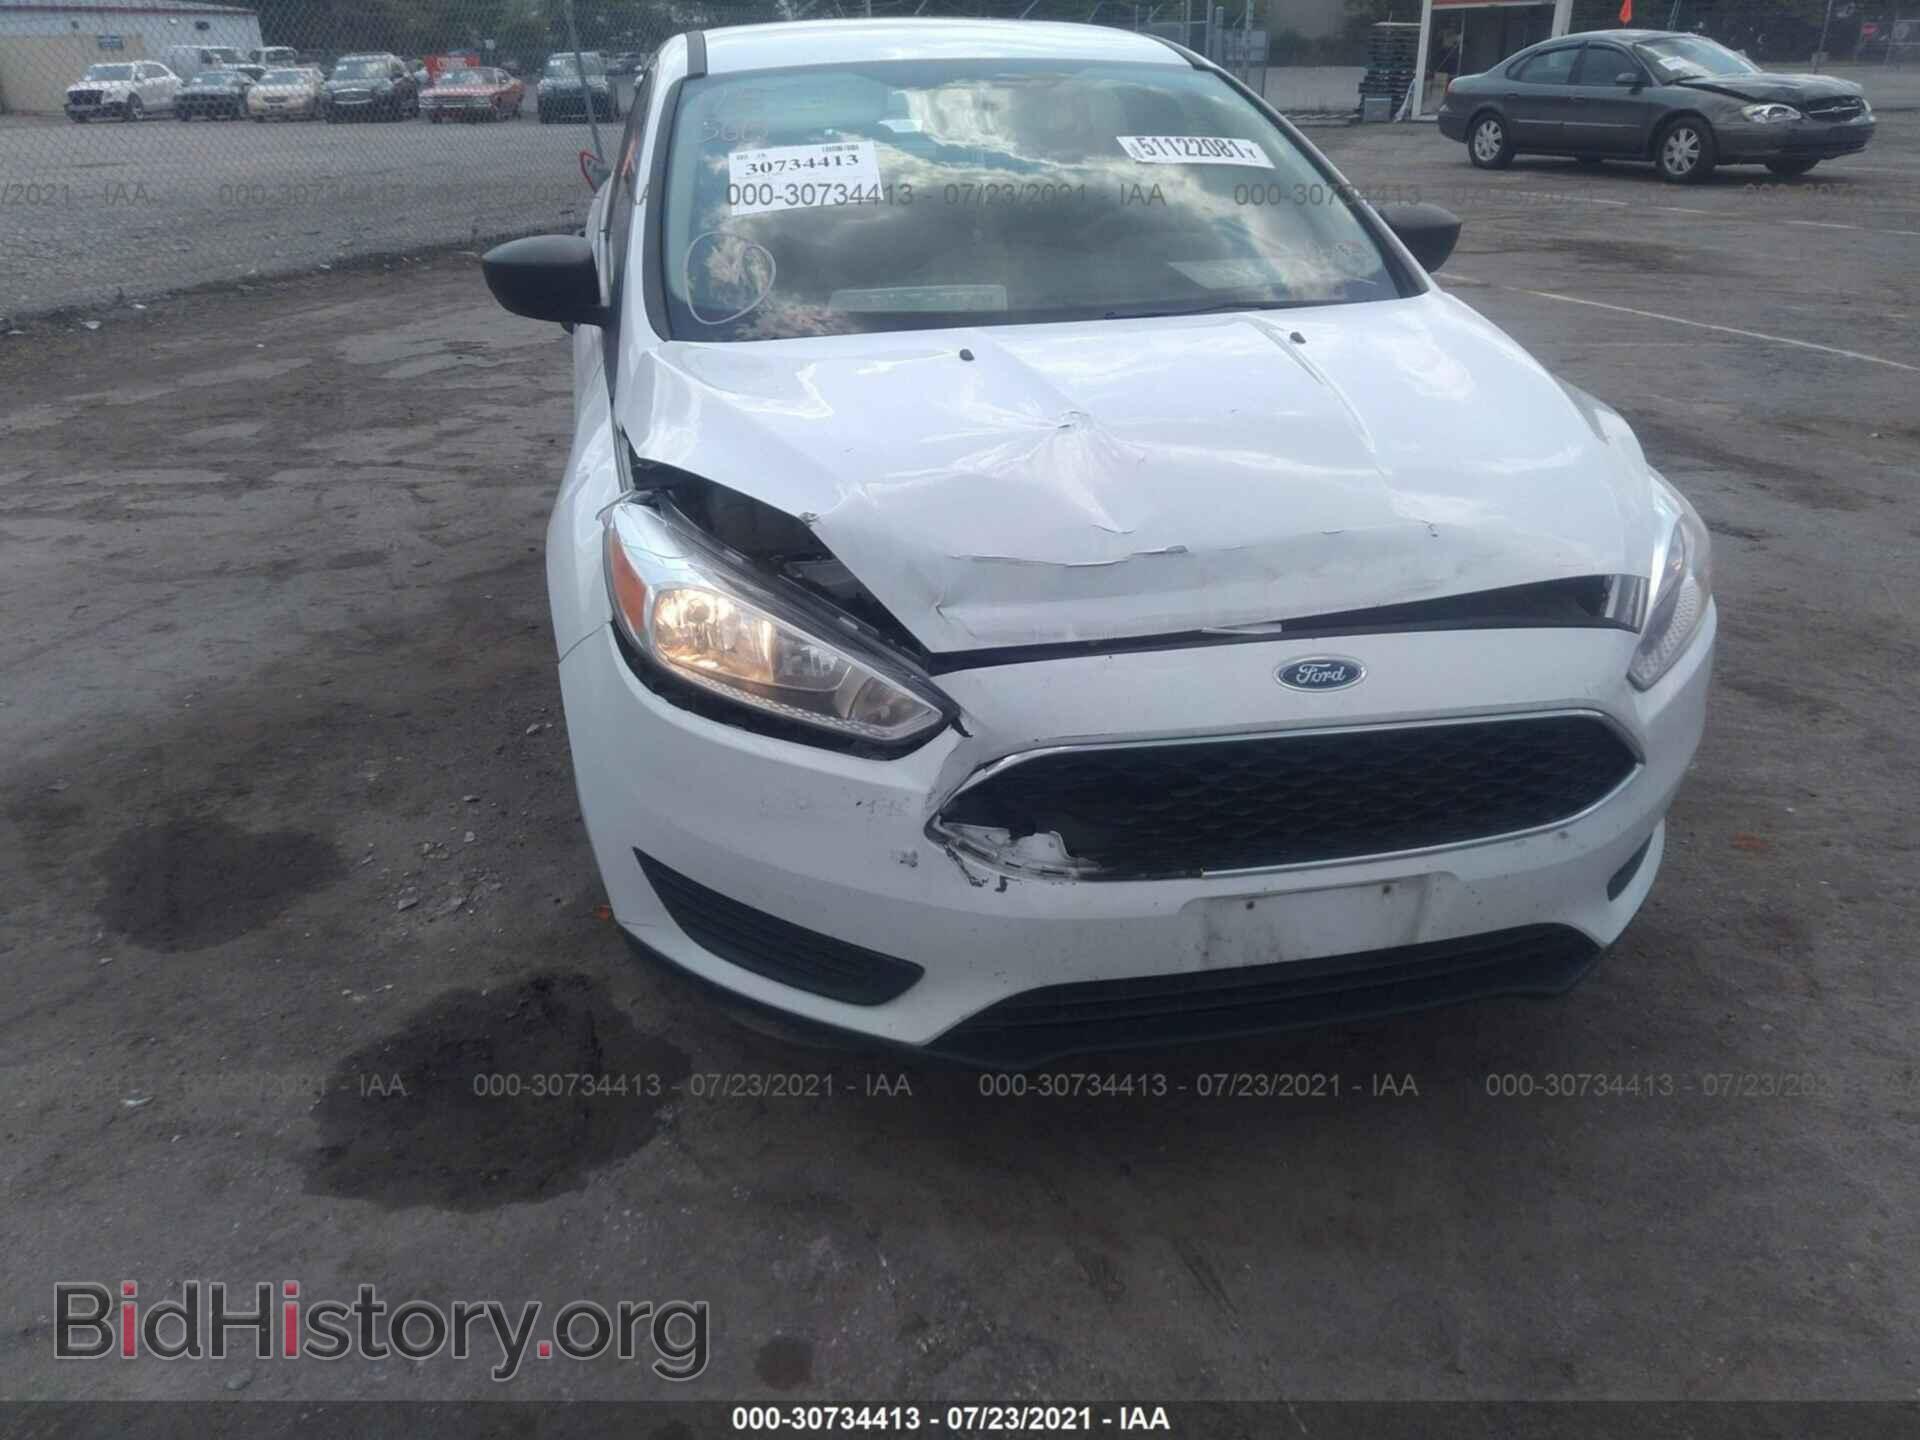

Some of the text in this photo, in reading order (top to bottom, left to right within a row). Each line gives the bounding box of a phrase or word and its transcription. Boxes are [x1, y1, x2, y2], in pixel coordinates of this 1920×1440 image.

[1135, 137, 1245, 158] 51122081
[745, 154, 859, 176] 30734413
[1296, 663, 1346, 684] Ford
